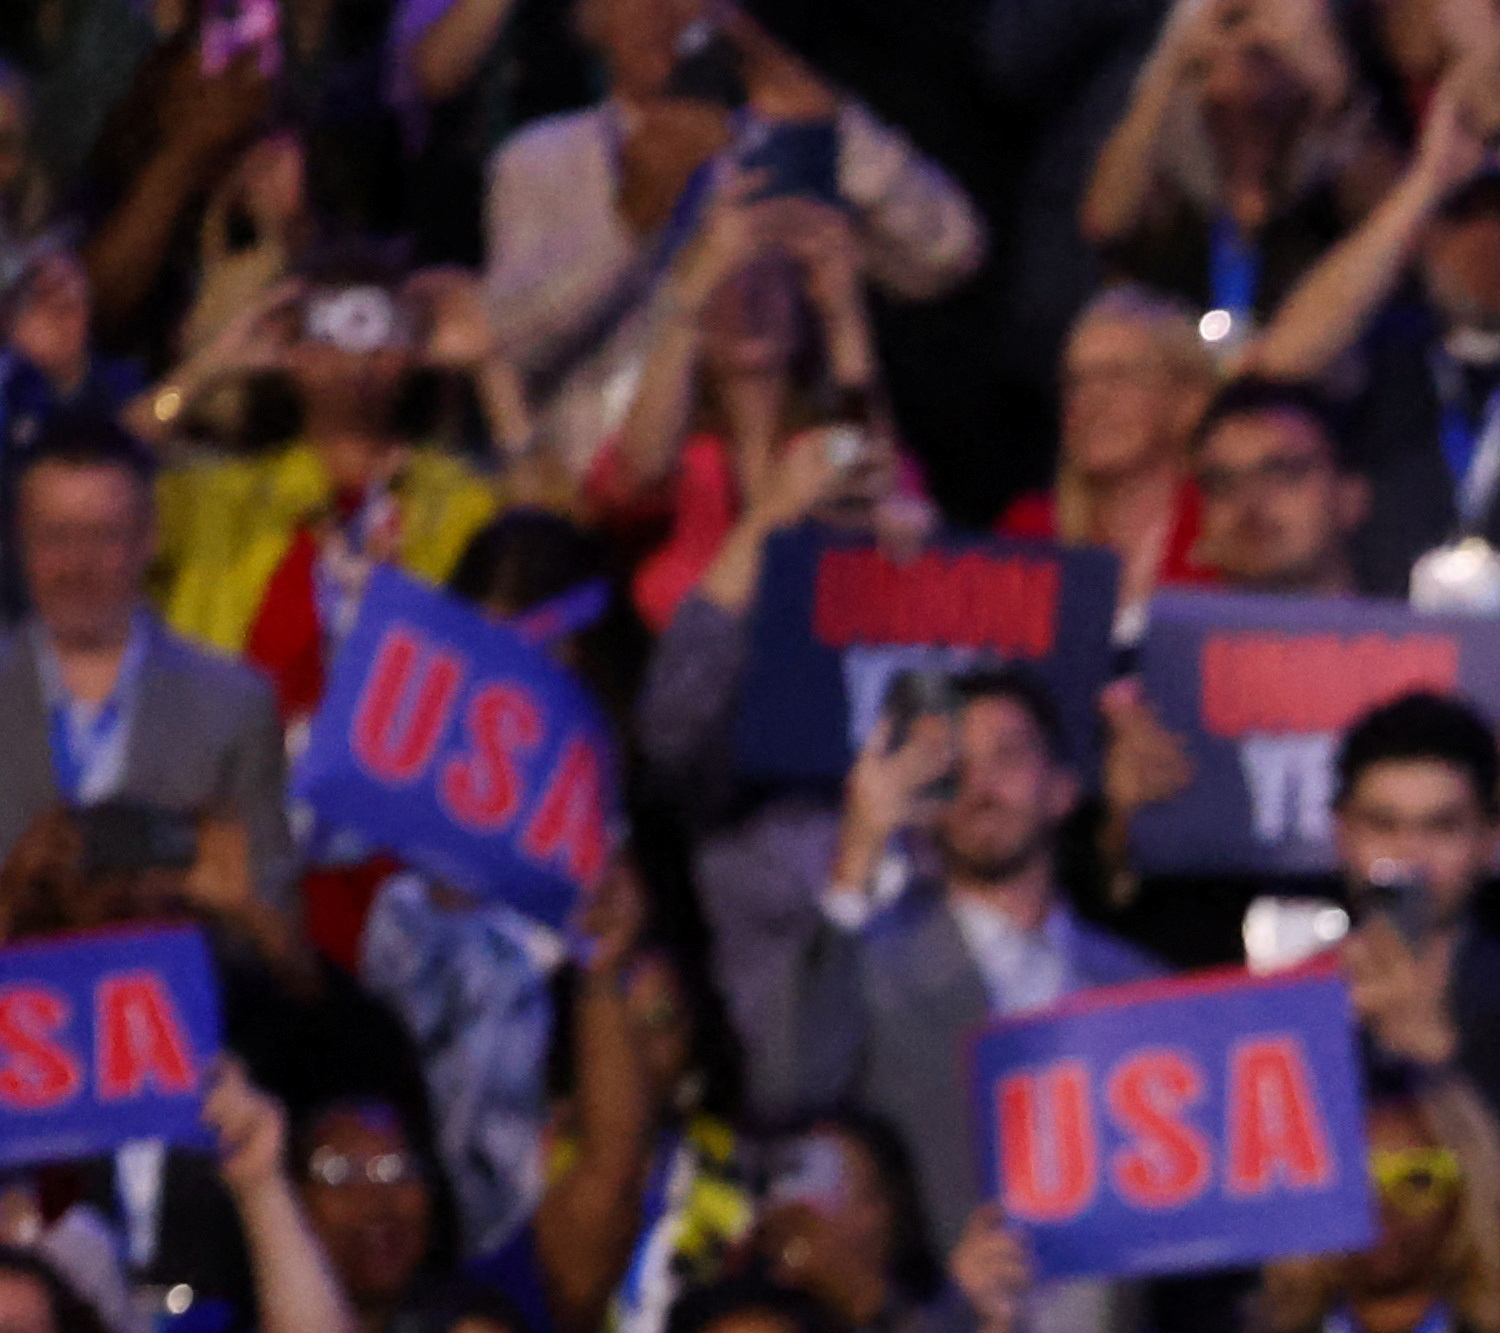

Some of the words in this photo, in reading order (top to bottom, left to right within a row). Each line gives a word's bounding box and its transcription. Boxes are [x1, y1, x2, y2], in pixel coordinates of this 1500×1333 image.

[350, 628, 608, 880] USA
[0, 970, 197, 1110] SA
[998, 1035, 1332, 1222] USA
